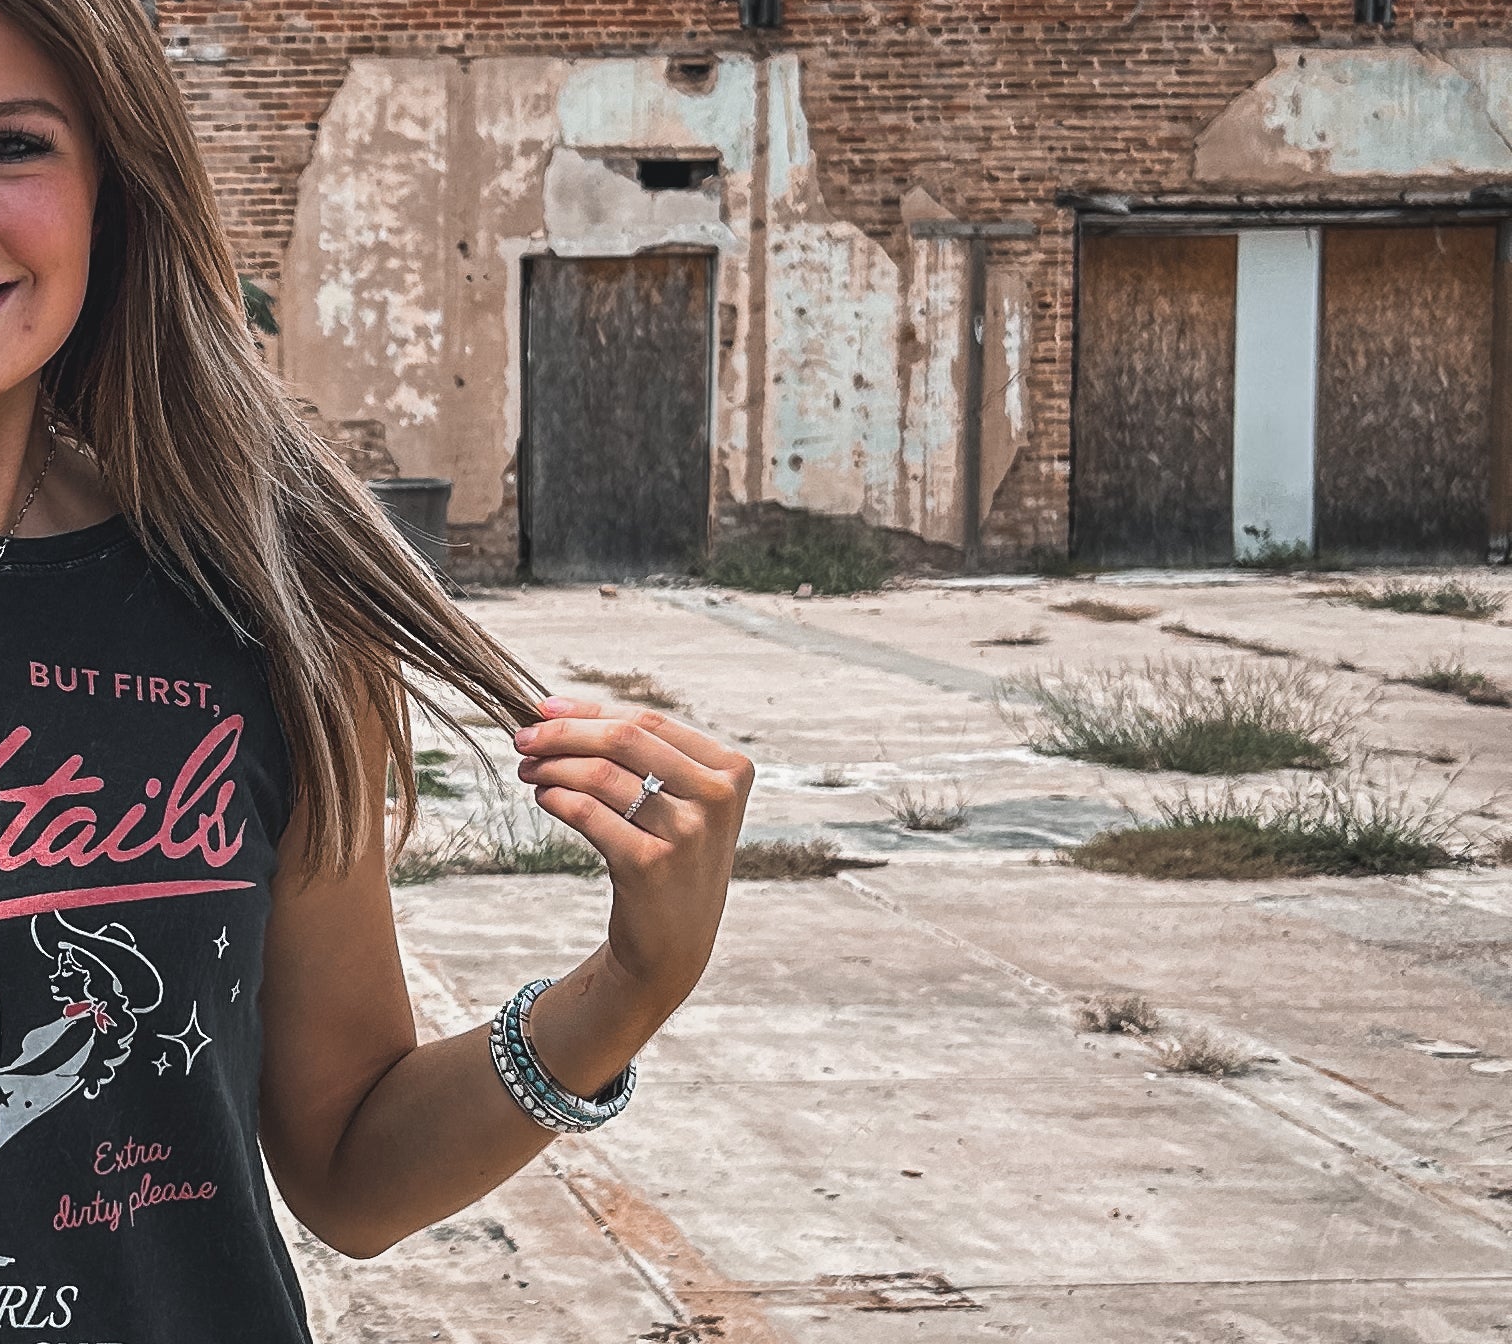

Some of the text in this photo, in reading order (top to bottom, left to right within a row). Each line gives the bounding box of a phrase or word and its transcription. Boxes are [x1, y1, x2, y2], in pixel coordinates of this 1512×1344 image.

[29, 661, 221, 718] BUT FIRST,
[94, 1136, 172, 1175] Extra
[53, 1172, 218, 1232] dirty please
